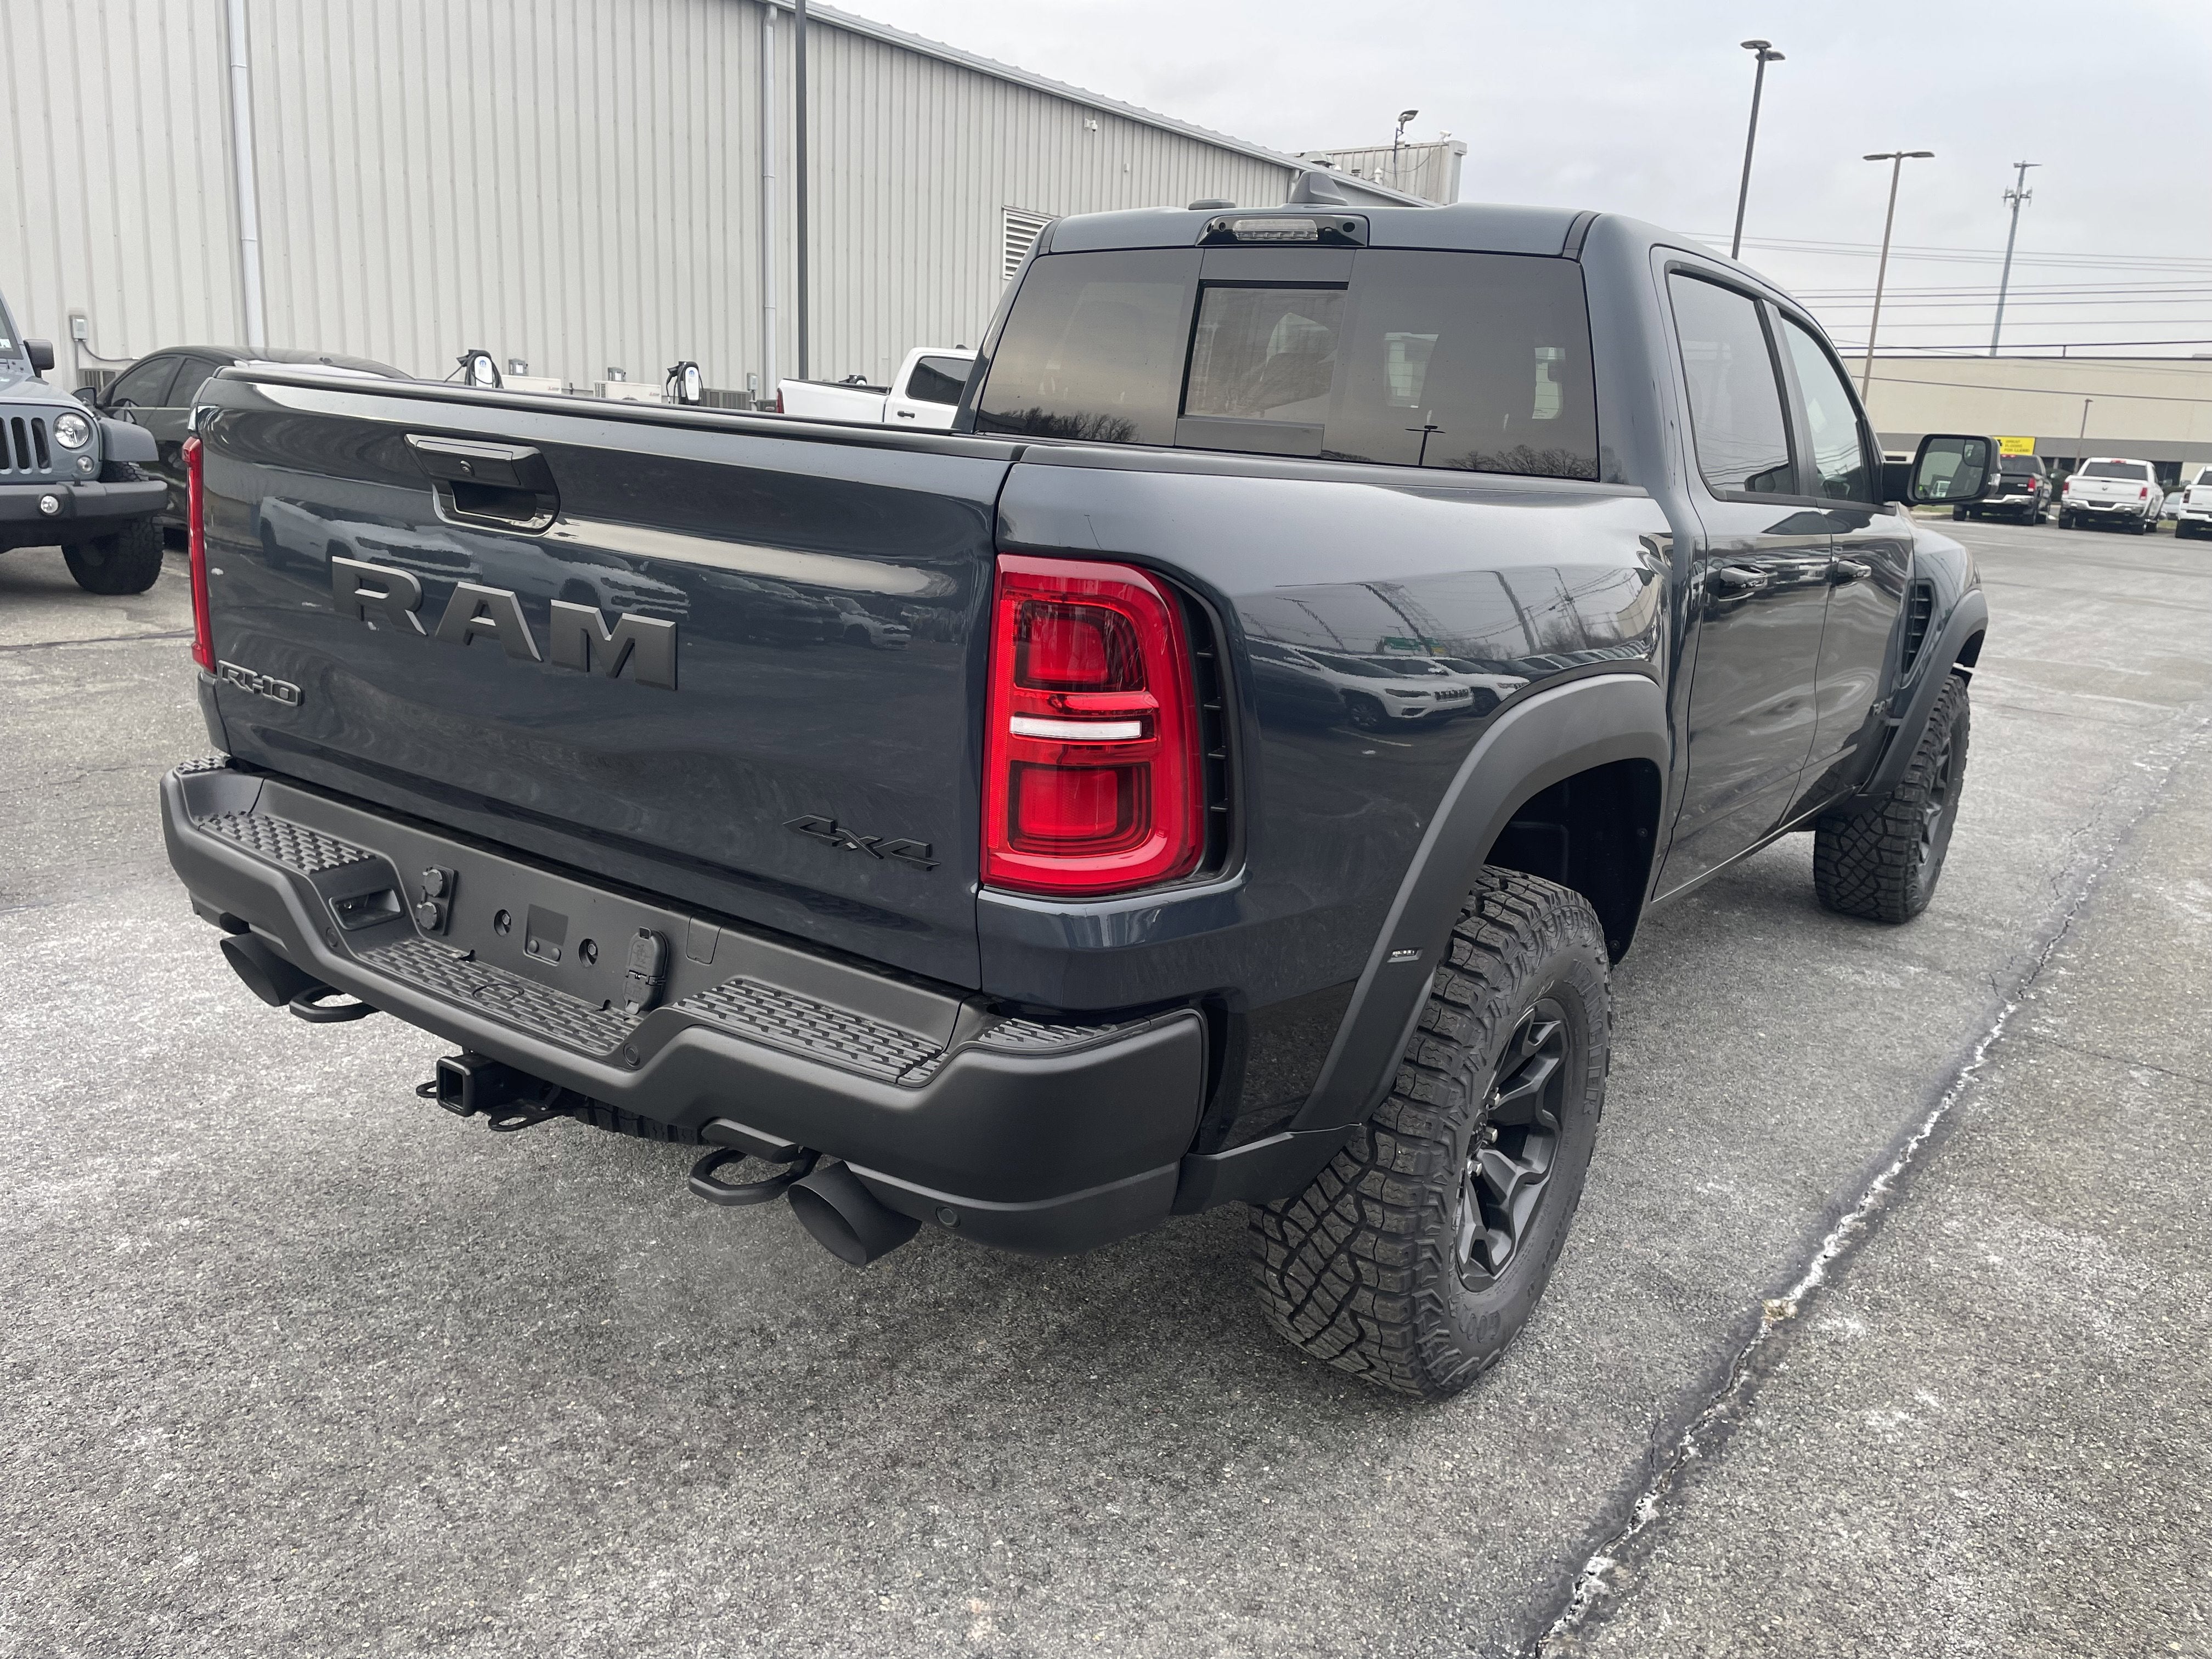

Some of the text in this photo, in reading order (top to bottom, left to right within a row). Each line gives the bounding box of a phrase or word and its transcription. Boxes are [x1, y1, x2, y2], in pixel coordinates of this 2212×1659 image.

[218, 659, 303, 707] RHO
[331, 556, 679, 691] RAM
[1564, 959, 1604, 1115] WRANGLER
